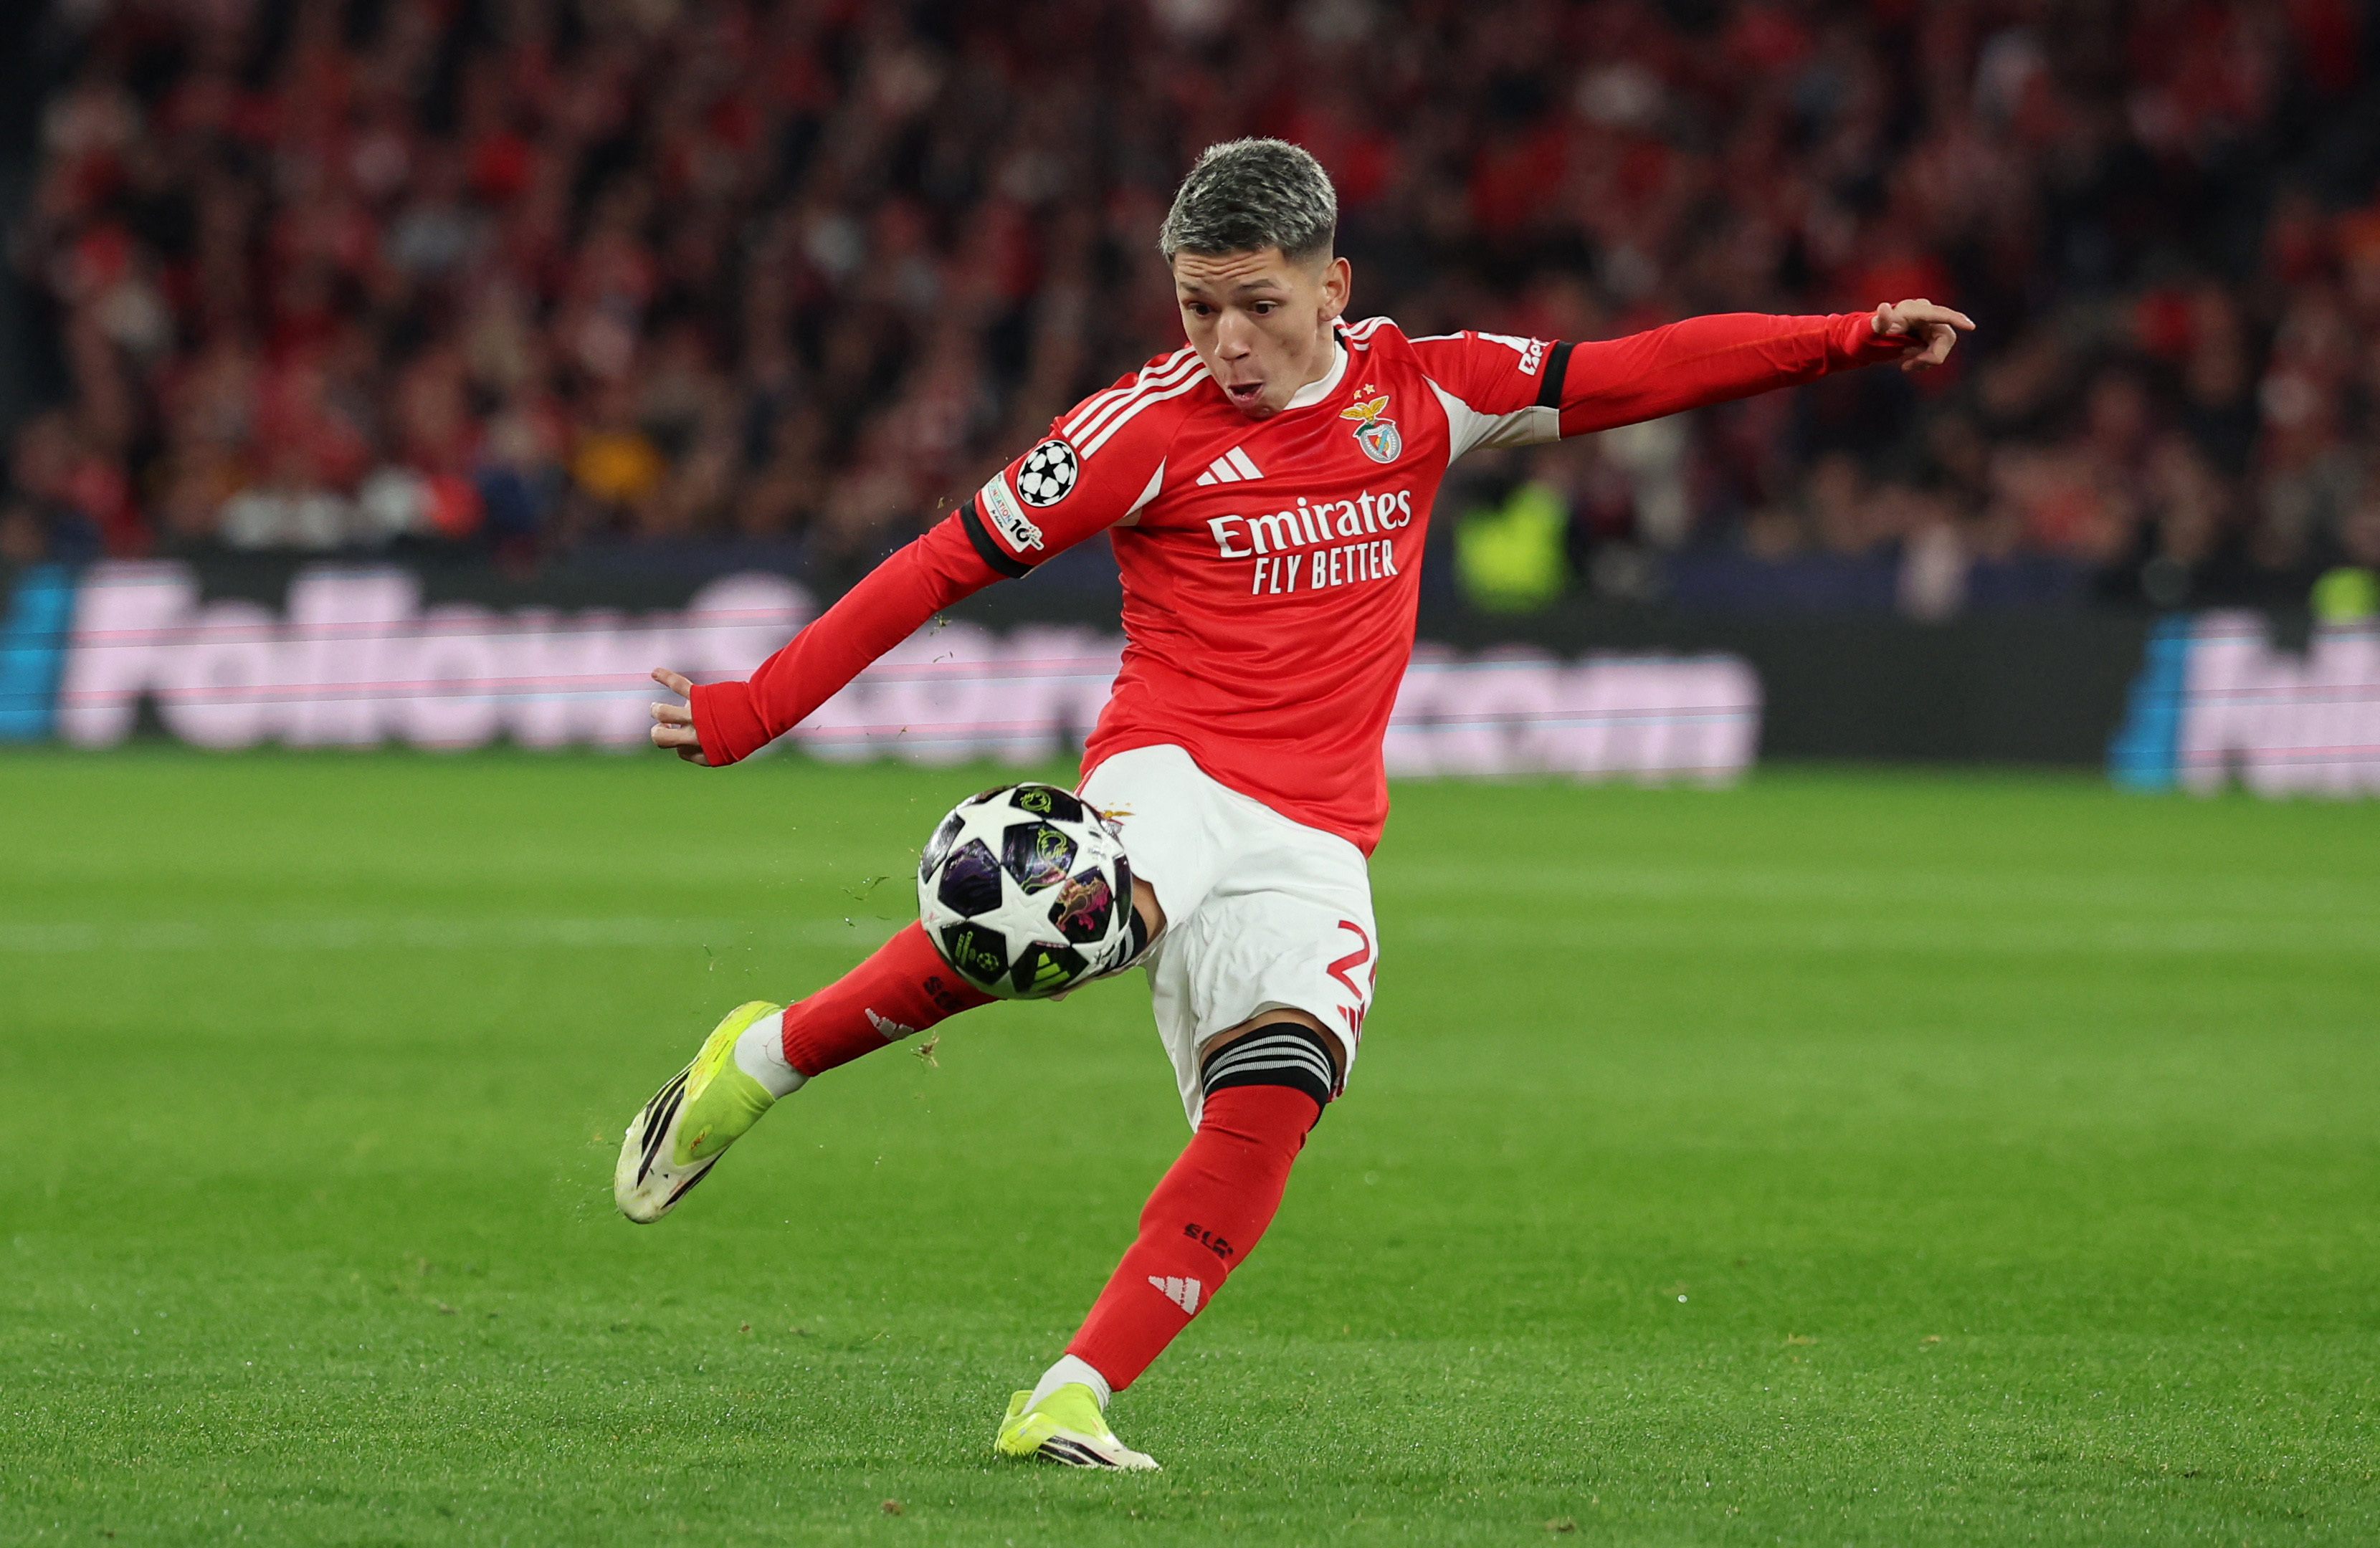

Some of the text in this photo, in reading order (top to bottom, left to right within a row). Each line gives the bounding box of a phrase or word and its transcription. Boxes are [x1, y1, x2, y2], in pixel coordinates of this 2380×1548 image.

[1009, 518, 1031, 543] 10
[1206, 489, 1412, 559] Emirates
[1252, 539, 1399, 596] FLY BETTER
[1325, 919, 1377, 1001] 2
